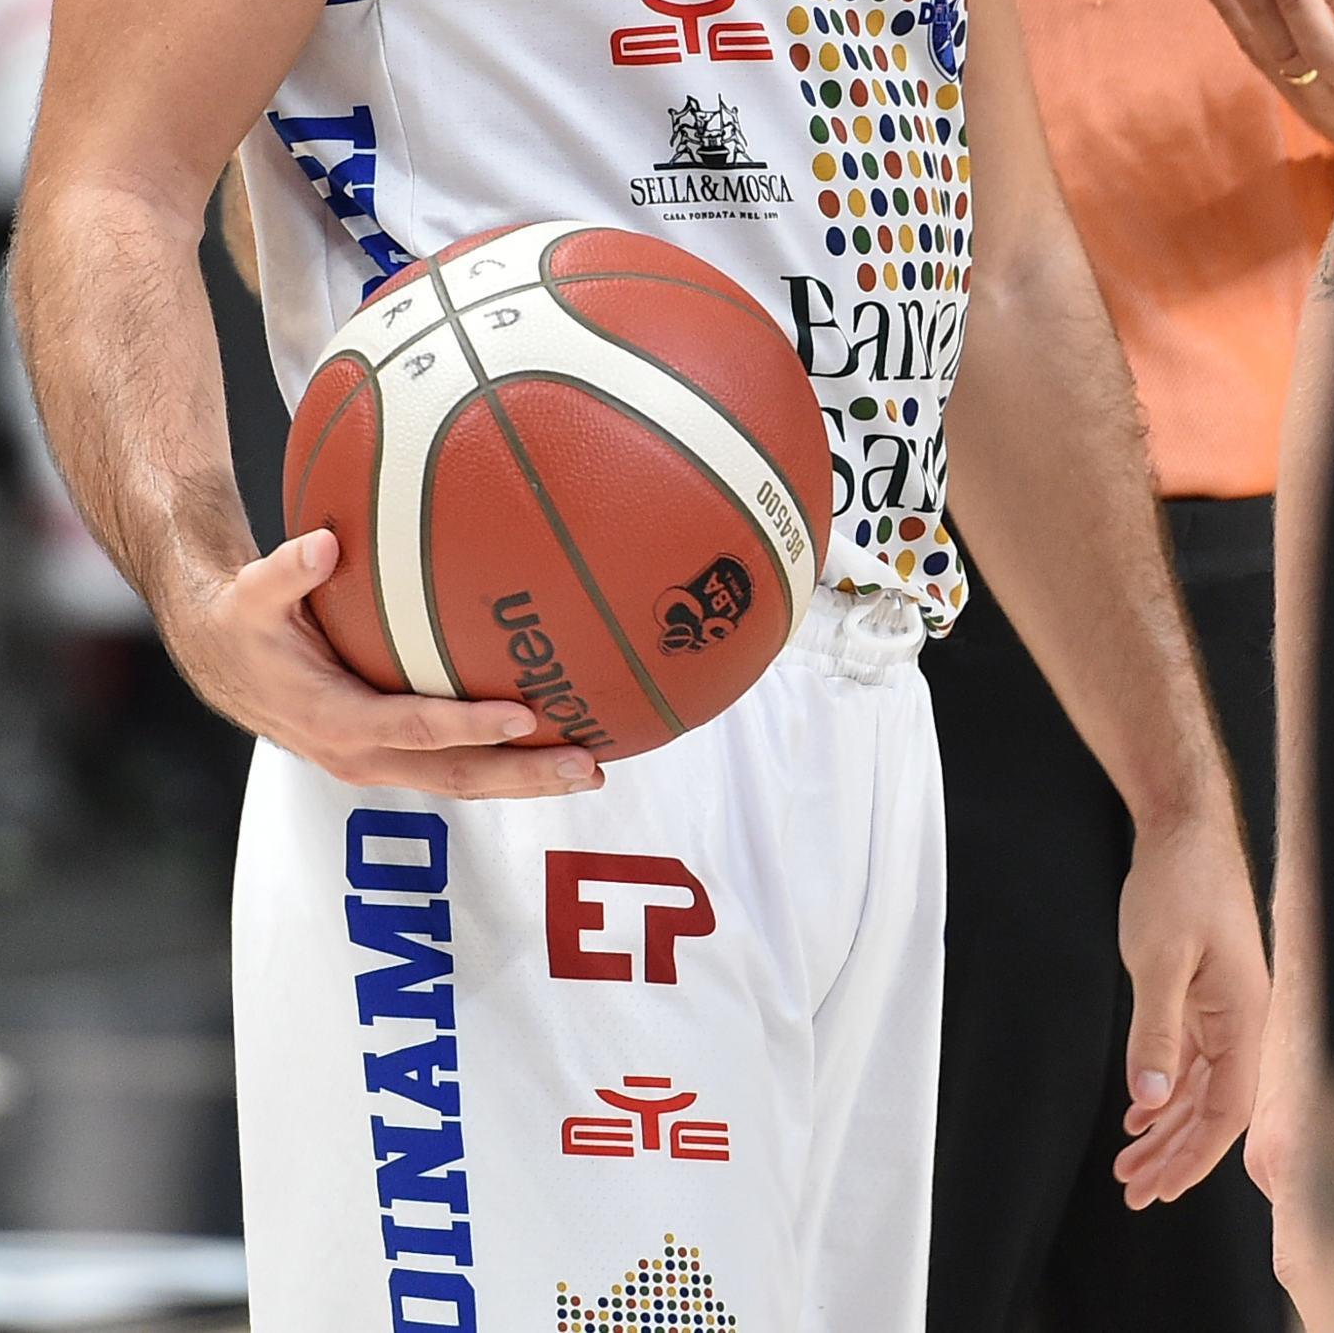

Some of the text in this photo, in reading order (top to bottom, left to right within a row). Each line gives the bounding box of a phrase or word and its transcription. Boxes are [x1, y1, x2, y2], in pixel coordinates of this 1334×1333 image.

[630, 174, 795, 206] SELLA&MOSCA
[663, 212, 686, 221] CASA
[688, 210, 736, 220] FONDATA
[739, 211, 761, 220] NEL
[704, 572, 741, 618] LBA
[492, 590, 615, 753] molten
[545, 850, 716, 984] EP
[344, 808, 478, 1333] DINAMO
